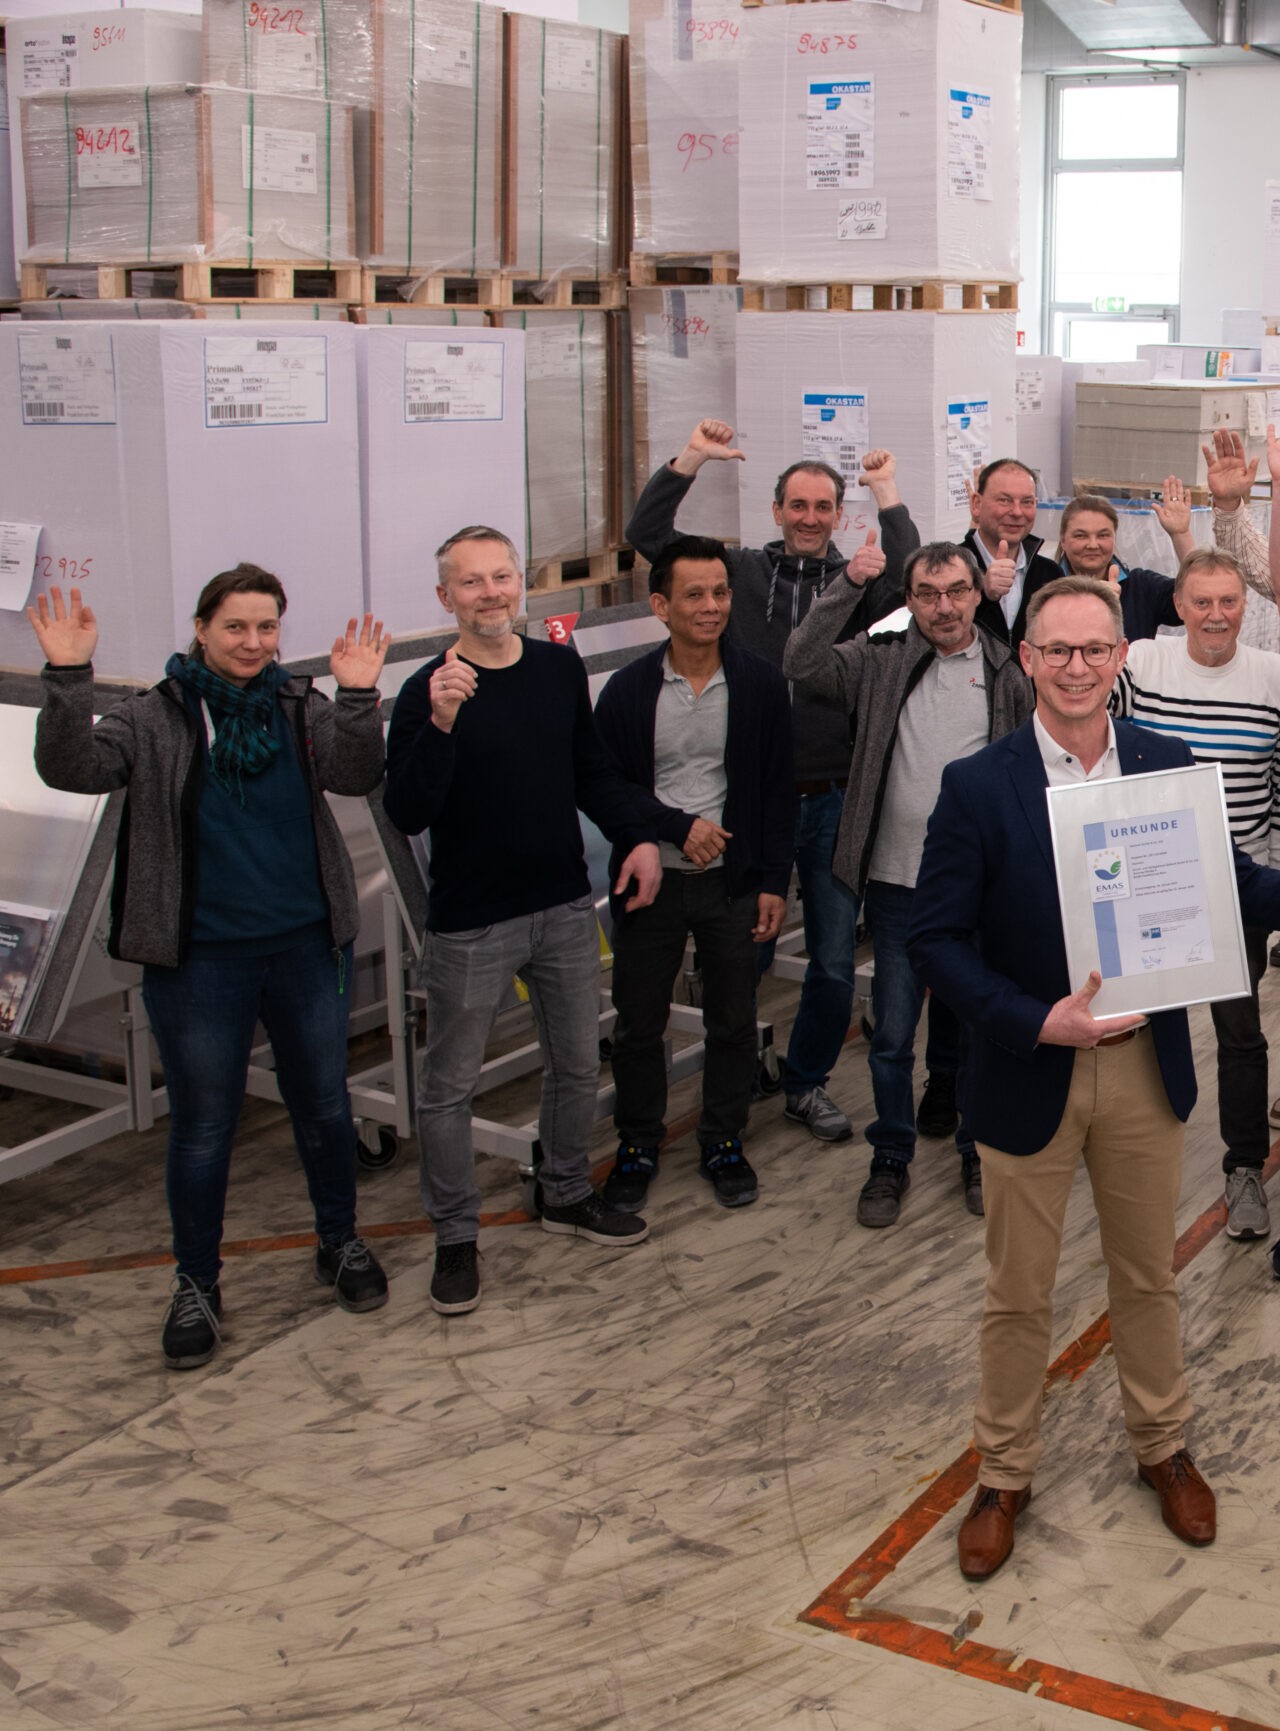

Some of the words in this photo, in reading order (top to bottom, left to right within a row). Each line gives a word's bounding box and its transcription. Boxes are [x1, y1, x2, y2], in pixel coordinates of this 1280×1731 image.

[831, 83, 871, 94] OKASTAR
[825, 397, 865, 407] OKASTAR
[551, 620, 567, 639] 3
[1110, 819, 1179, 838] URKUNDE
[1095, 882, 1124, 893] EMAS
